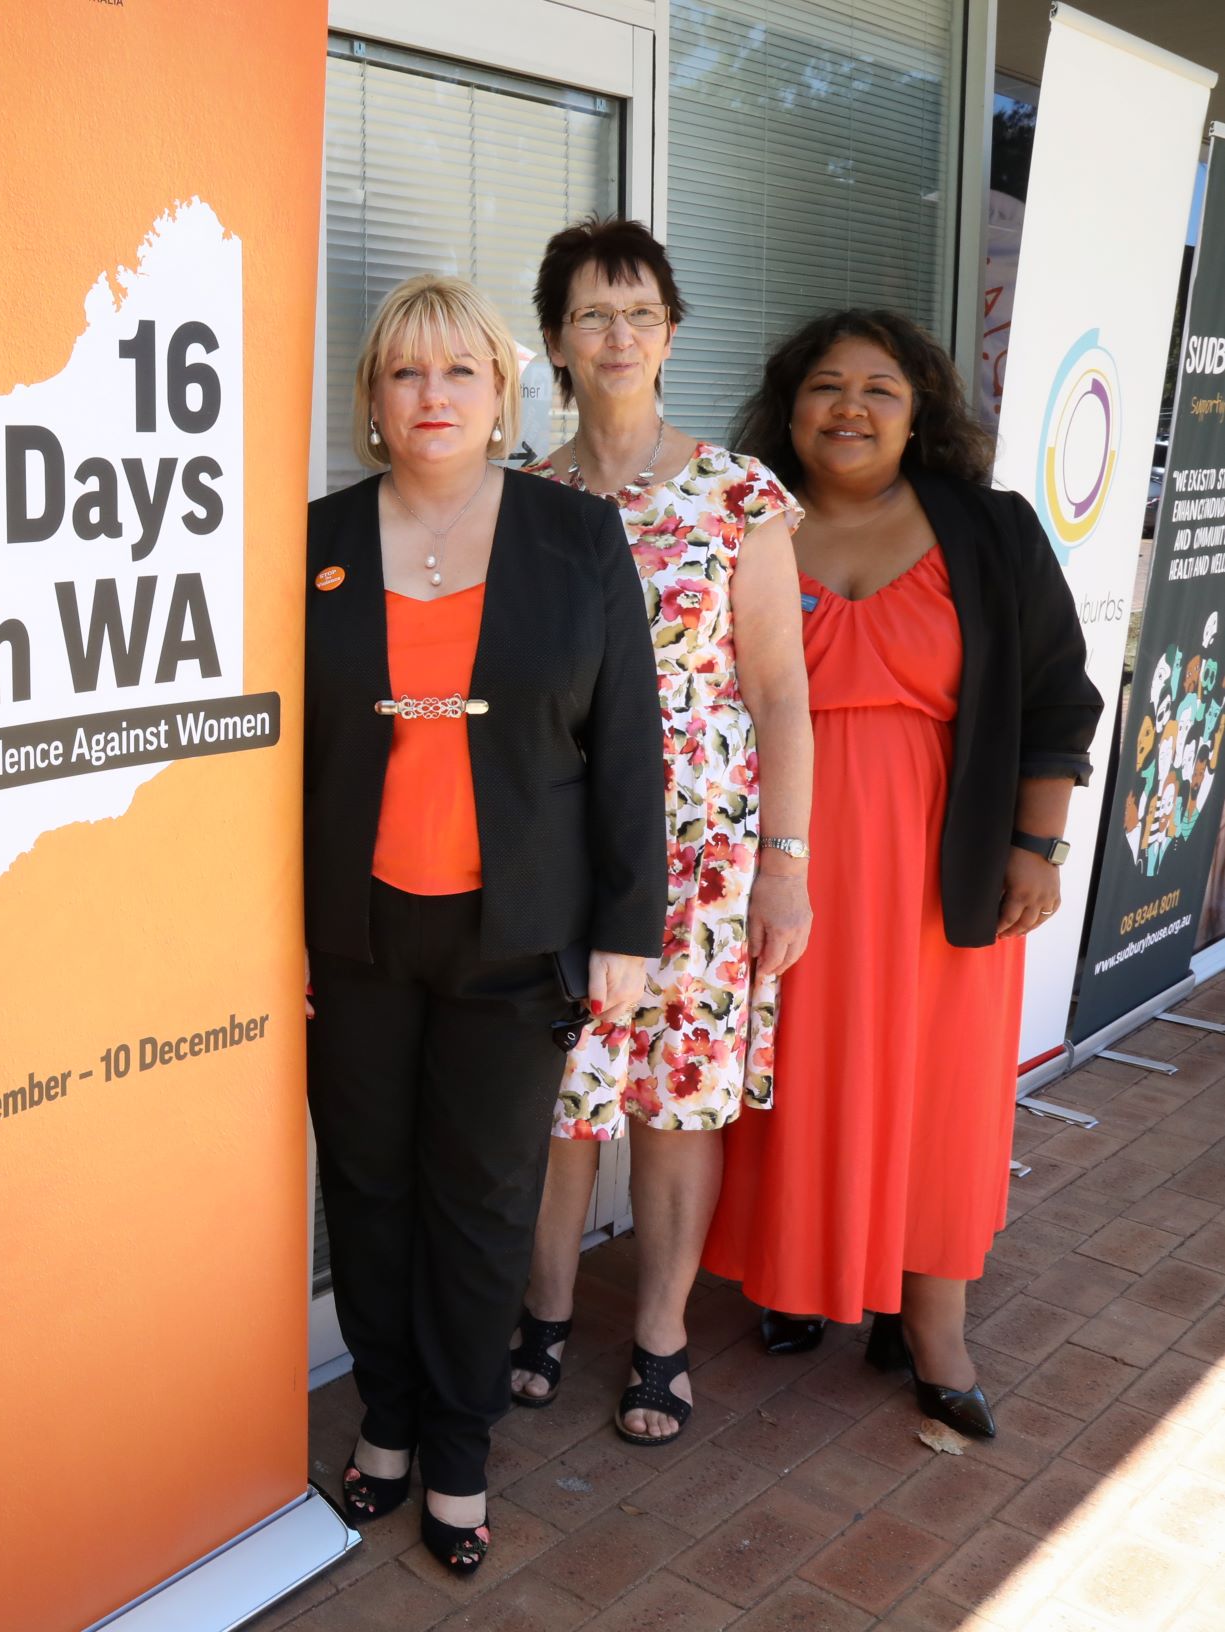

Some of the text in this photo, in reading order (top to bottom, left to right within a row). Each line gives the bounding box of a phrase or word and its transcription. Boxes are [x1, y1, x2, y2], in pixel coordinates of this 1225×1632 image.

[118, 320, 222, 434] 16
[1185, 335, 1225, 375] SUDB
[519, 383, 541, 399] ther
[5, 424, 224, 562] Days
[1174, 528, 1192, 551] AND
[1193, 555, 1210, 577] AND
[54, 572, 223, 694] WA
[1078, 591, 1124, 624] burbs
[71, 719, 169, 766] Against
[176, 711, 270, 746] Women
[1120, 888, 1181, 935] 08 9344 8011
[1094, 913, 1192, 975] www.sudburyhouse.org.au
[100, 1043, 130, 1083] 10
[139, 1013, 269, 1072] December
